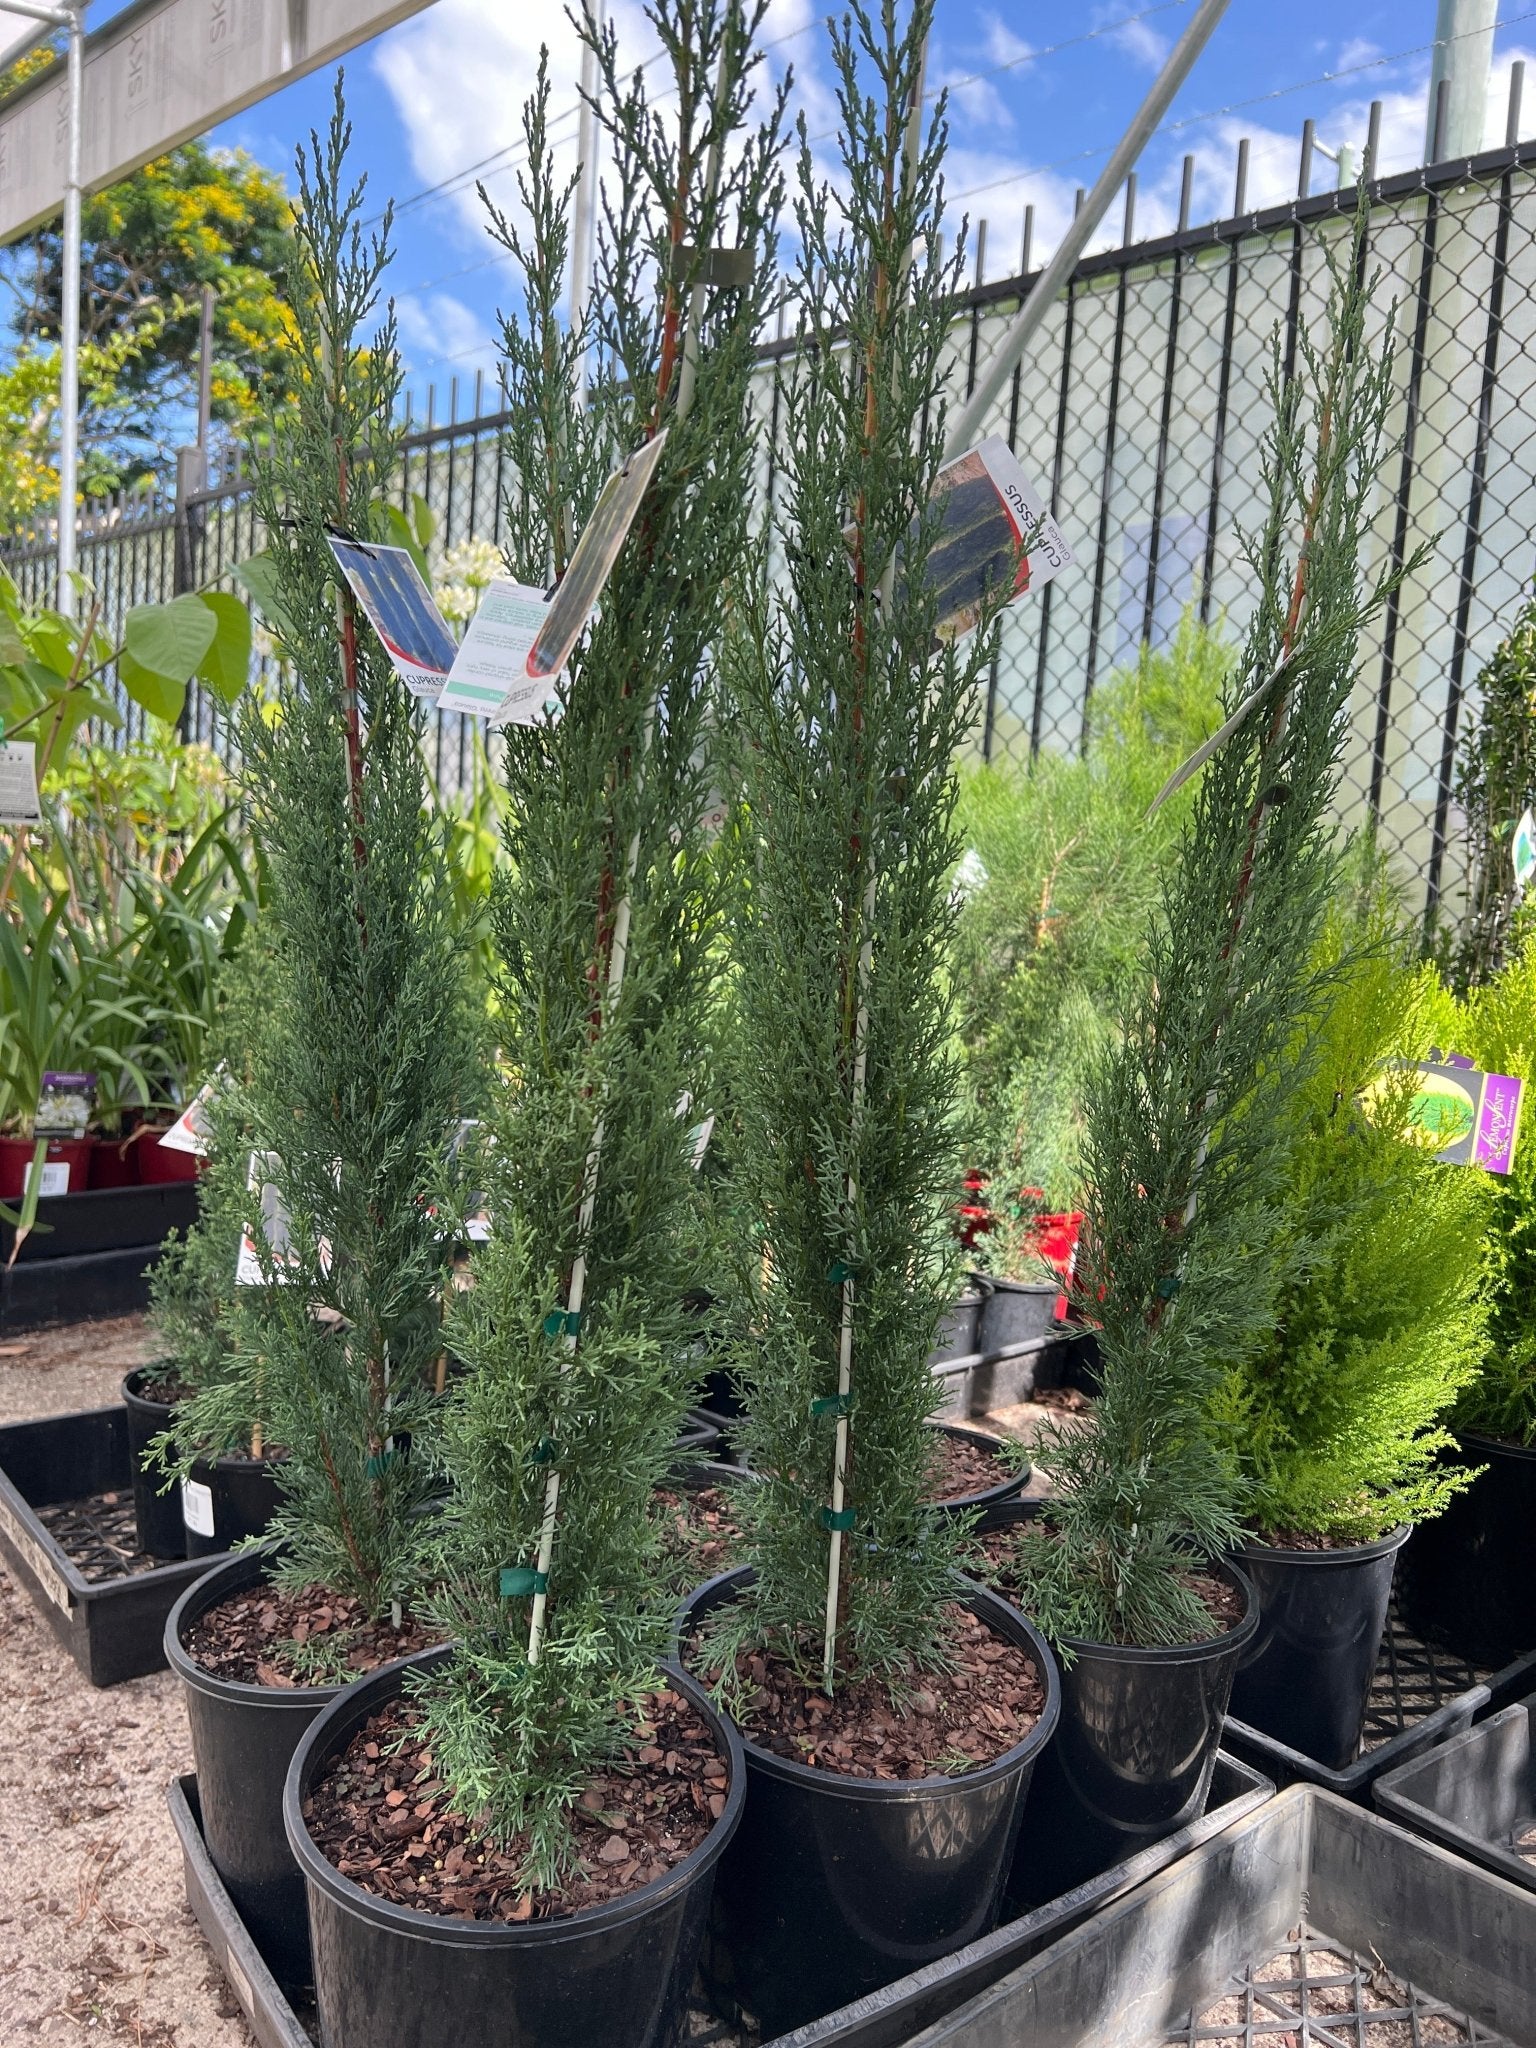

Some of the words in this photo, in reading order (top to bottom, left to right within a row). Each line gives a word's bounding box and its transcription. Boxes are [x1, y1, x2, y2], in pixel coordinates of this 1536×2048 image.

[209, 0, 226, 43] SK
[128, 35, 143, 98] SKY
[1047, 526, 1071, 561] Glauca
[406, 674, 447, 687] CUPRESS
